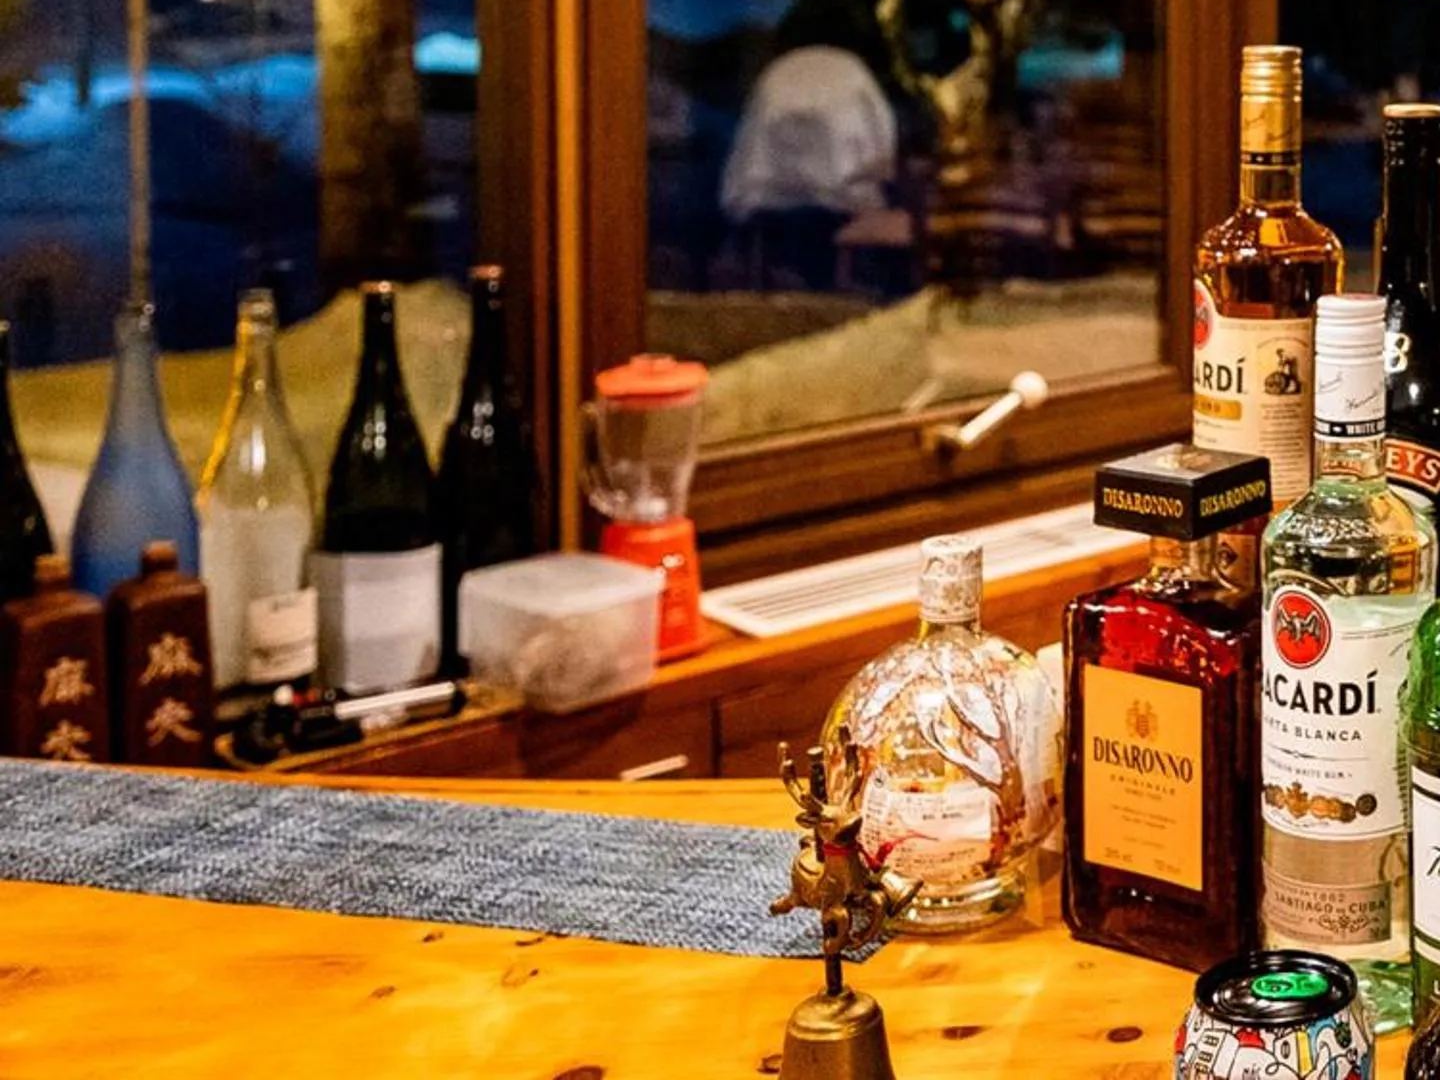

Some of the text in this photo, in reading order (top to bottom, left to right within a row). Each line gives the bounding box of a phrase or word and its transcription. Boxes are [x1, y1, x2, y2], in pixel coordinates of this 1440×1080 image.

[1386, 445, 1440, 482] EYS
[1103, 487, 1185, 519] DISARONNO
[1200, 478, 1267, 517] DISARONNO
[1262, 668, 1380, 717] ACARDÍ
[1294, 726, 1363, 742] BLANCA
[1093, 734, 1194, 784] DISARONNO
[1275, 890, 1334, 914] SANTIAGO
[1349, 900, 1386, 914] CUBA
